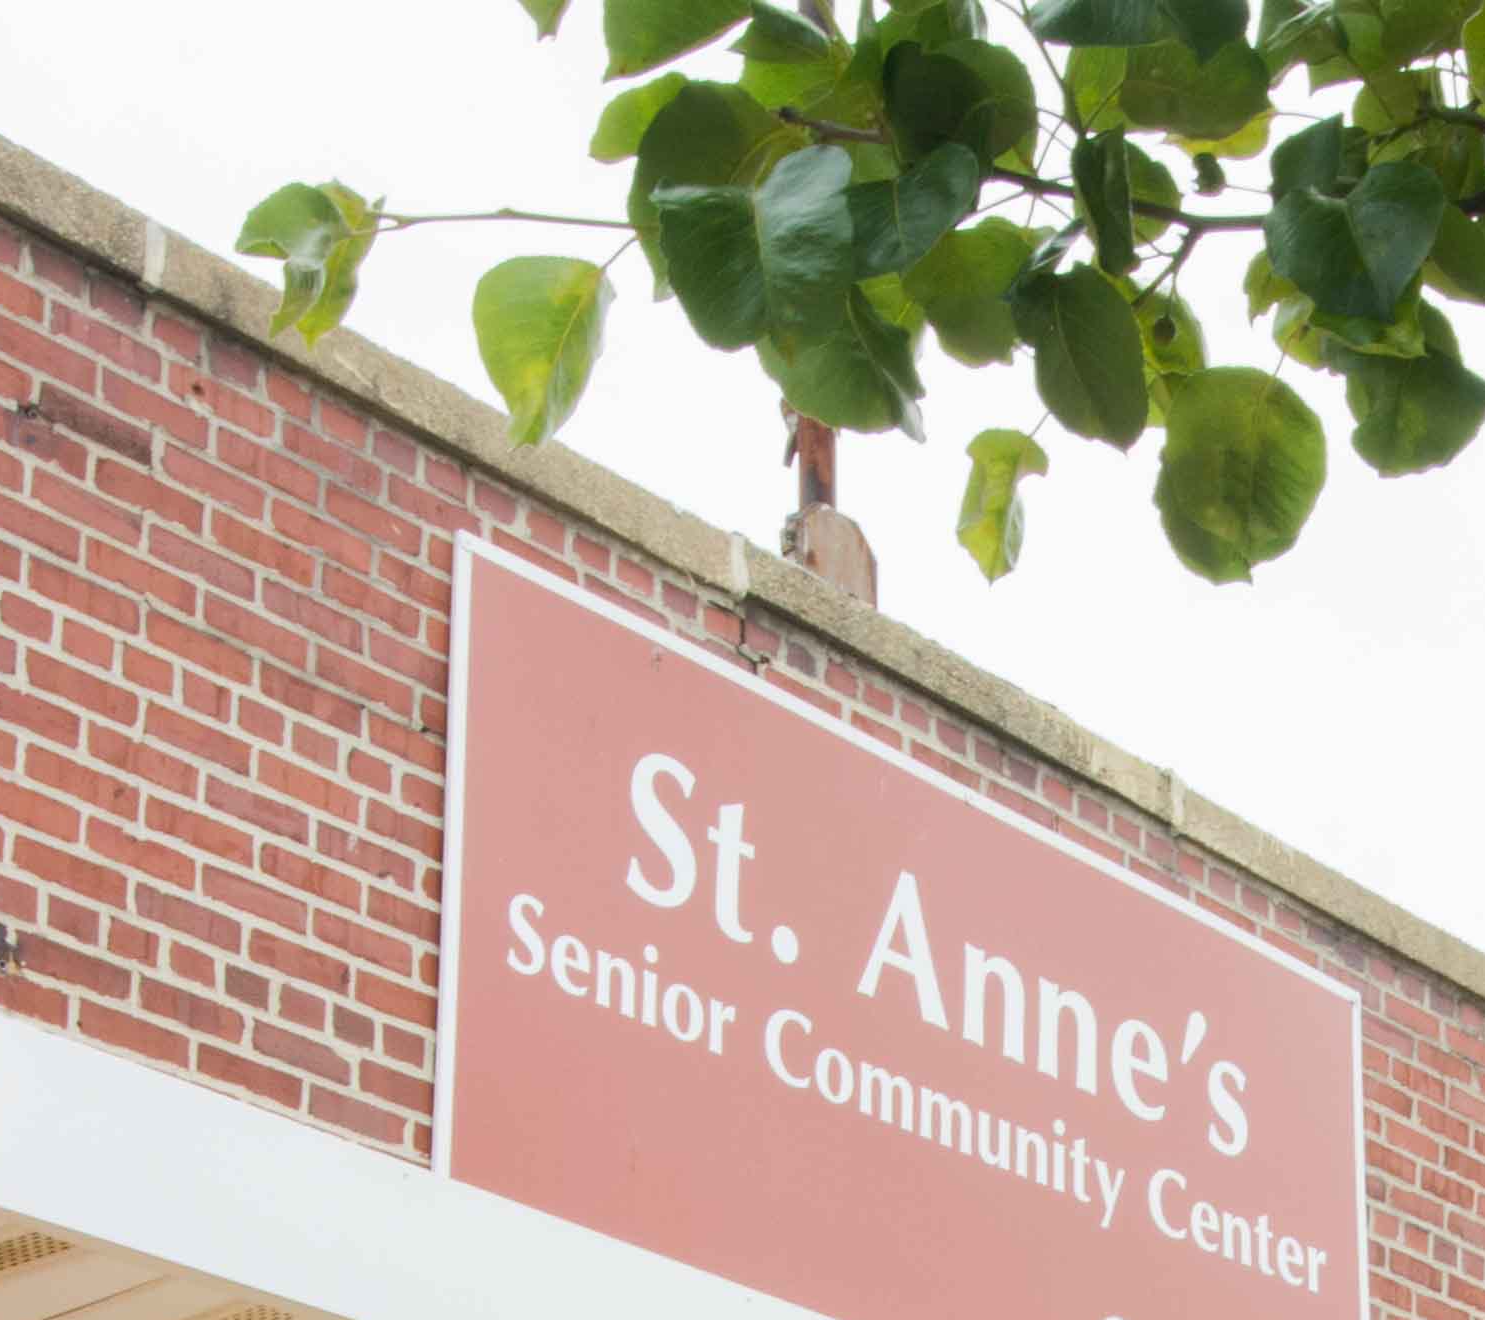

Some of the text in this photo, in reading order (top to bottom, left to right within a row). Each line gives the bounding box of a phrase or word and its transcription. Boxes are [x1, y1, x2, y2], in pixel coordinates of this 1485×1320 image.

[506, 892, 1327, 1294] Senior Community Center
[625, 752, 1248, 1156] St. Anne's
